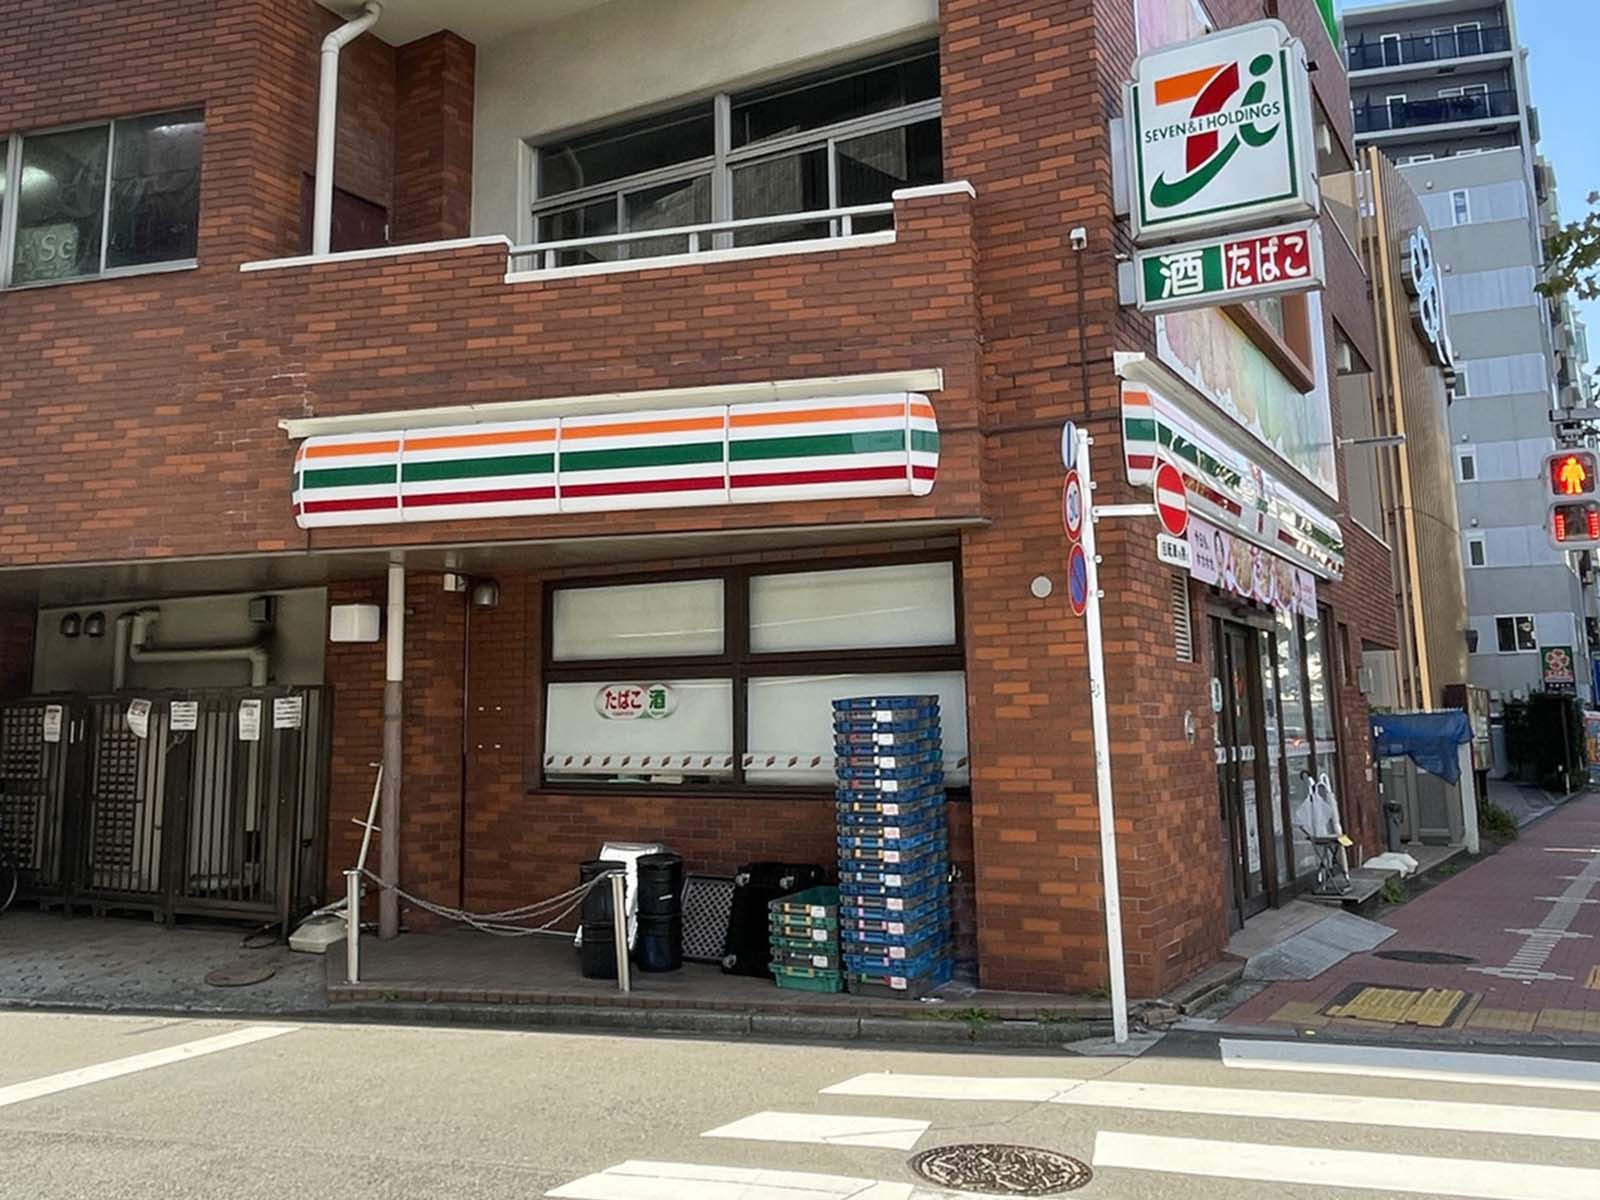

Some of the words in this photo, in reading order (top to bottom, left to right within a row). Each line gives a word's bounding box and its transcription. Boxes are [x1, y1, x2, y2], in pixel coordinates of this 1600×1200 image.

[1206, 101, 1281, 129] HOLDINGS
[1159, 250, 1205, 298] 酒
[1227, 236, 1307, 287] たばこ
[604, 689, 643, 710] たばこ
[648, 688, 667, 710] 酒
